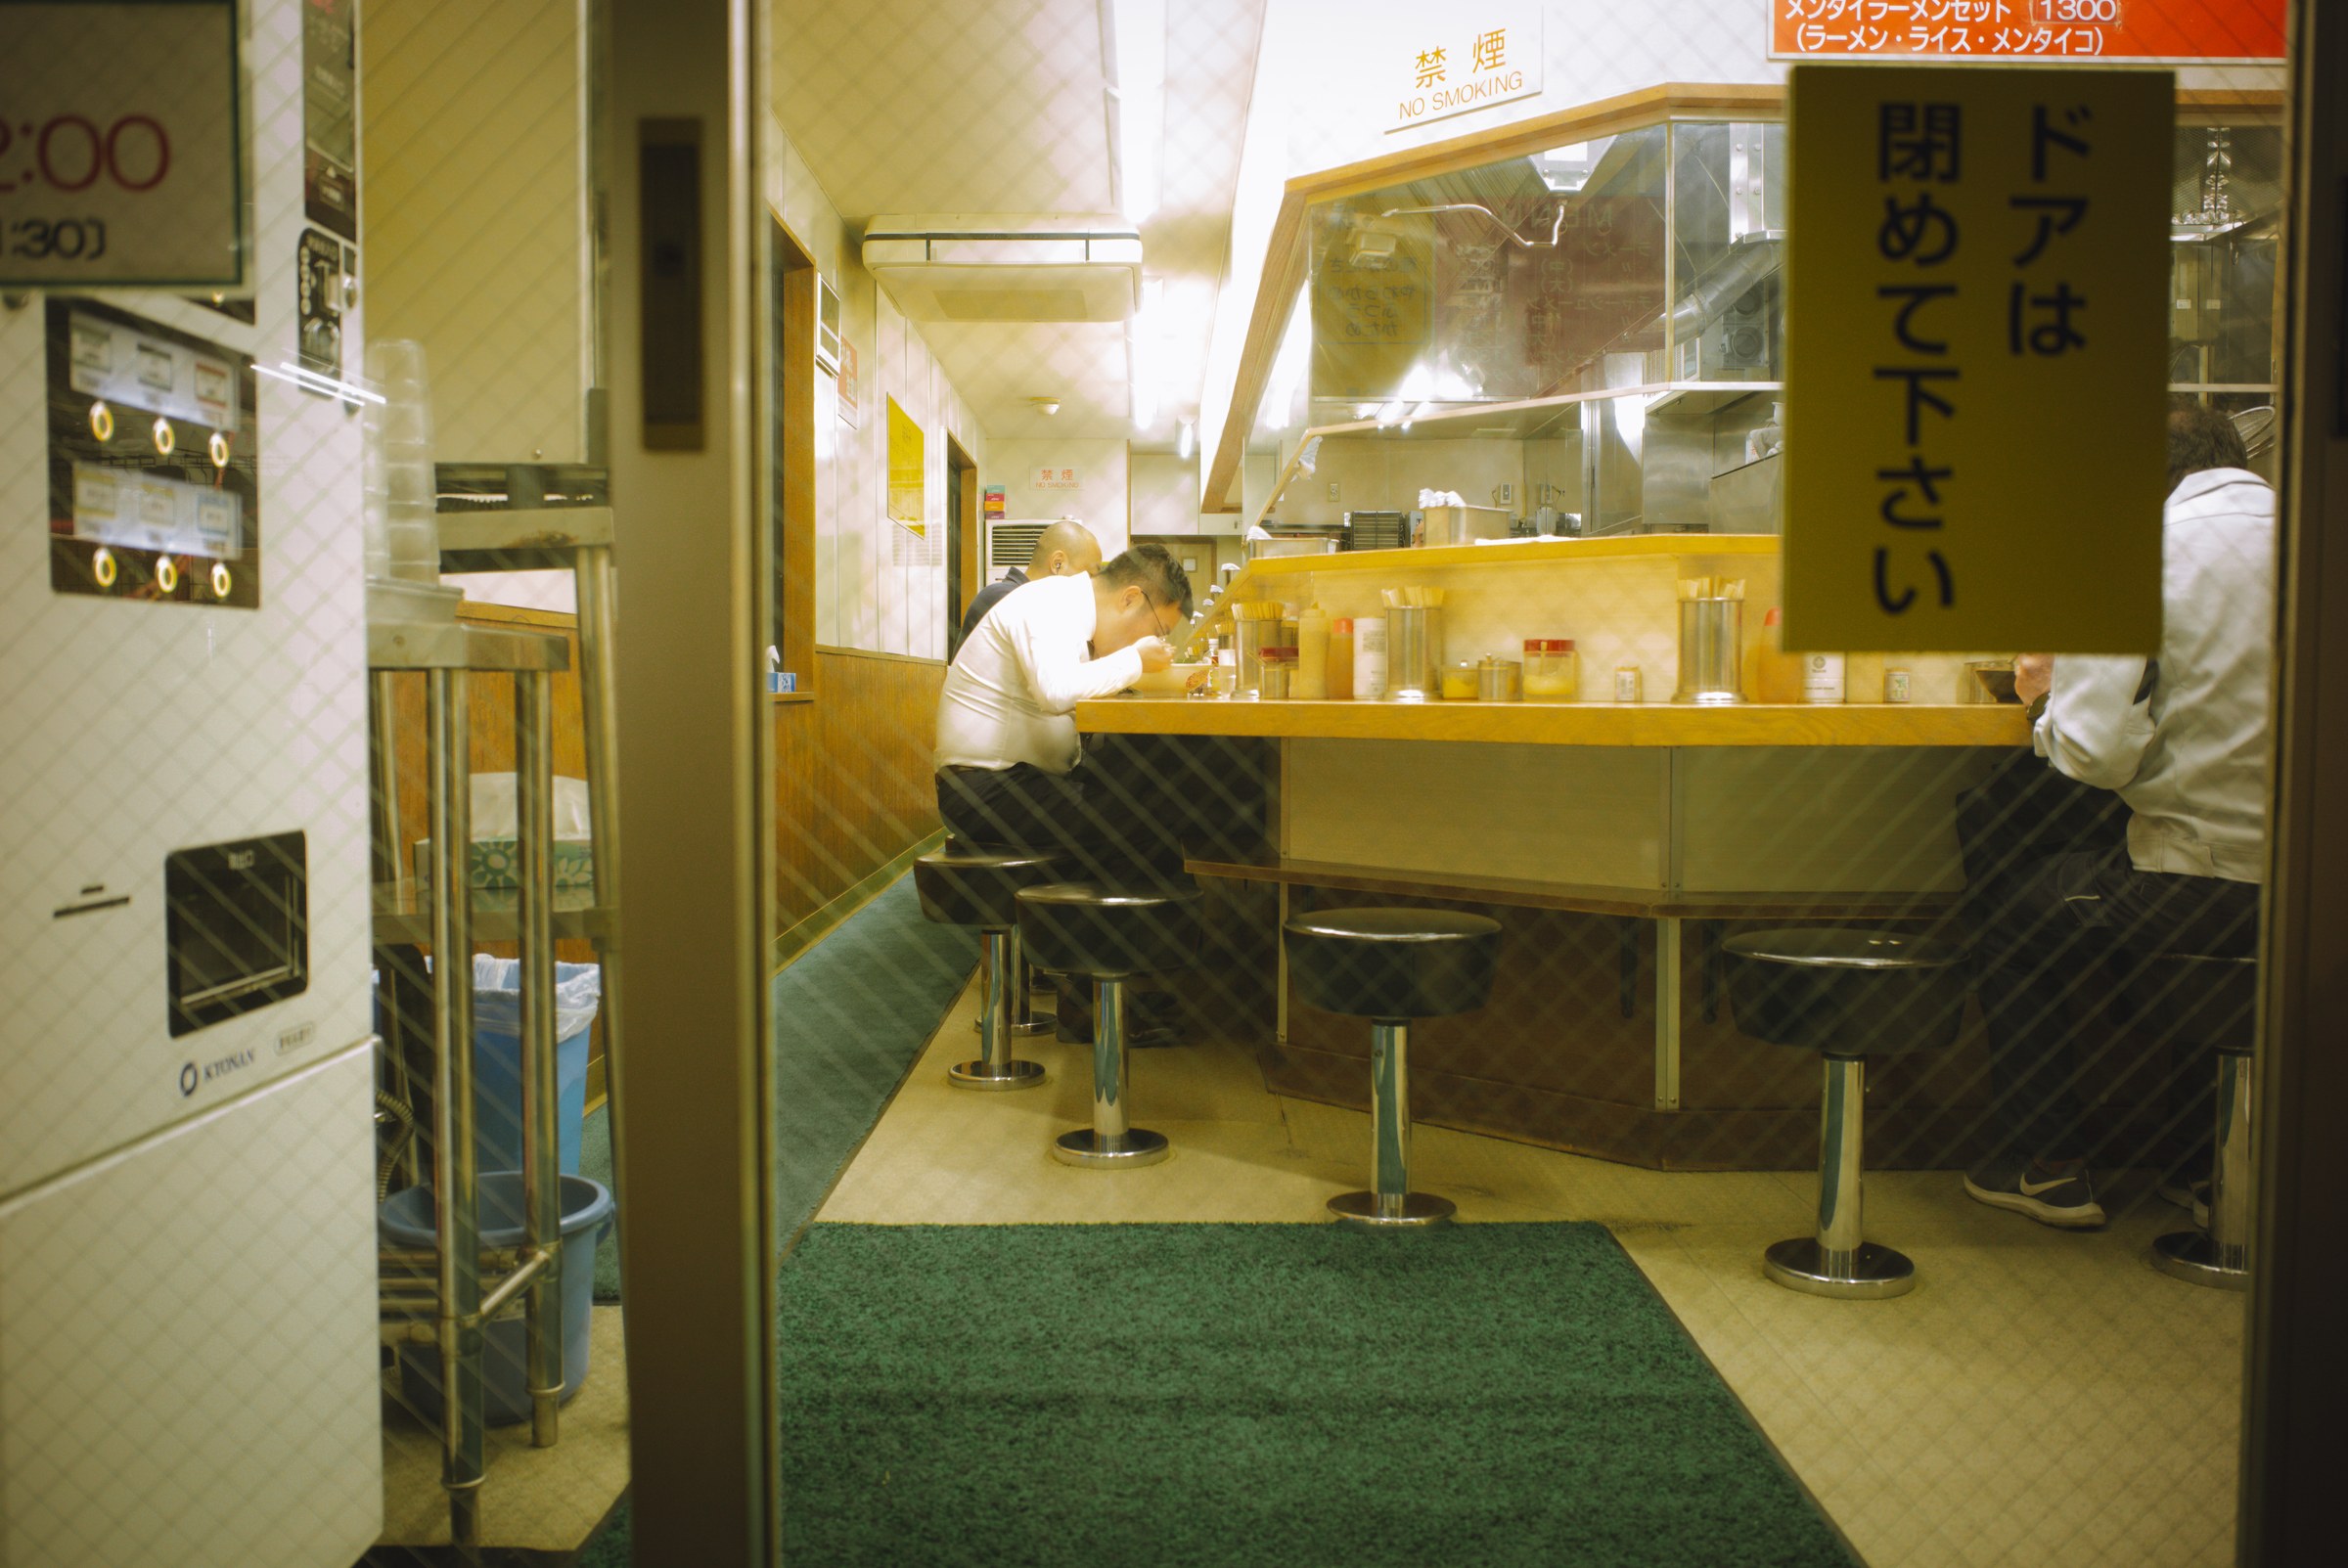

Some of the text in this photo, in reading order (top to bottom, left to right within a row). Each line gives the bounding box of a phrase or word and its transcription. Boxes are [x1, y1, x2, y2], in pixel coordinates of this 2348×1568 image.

[2041, 0, 2117, 22] 1300
[1399, 70, 1522, 119] NO SMOKING
[2008, 103, 2093, 357] ドアは
[1872, 102, 1962, 616] 閉めて下さい
